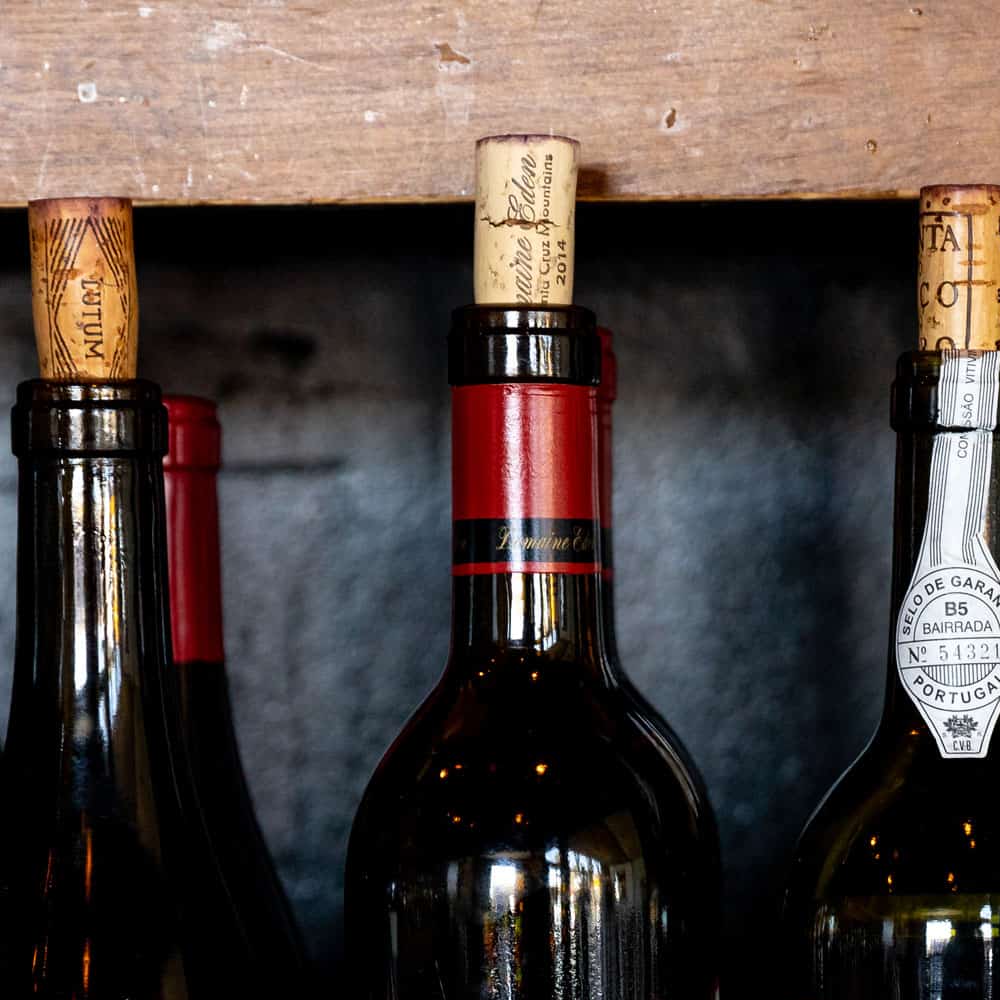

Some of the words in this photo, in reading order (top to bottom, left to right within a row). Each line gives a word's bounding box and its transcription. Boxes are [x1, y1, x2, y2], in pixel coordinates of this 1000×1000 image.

[536, 154, 554, 237] Mountains
[539, 240, 551, 276] Cruz
[556, 239, 568, 286] 2014
[81, 279, 105, 360] LUTUM
[902, 593, 924, 635] SELO
[924, 577, 945, 595] DE
[922, 619, 993, 635] BAIRRADA
[944, 601, 969, 616] B5
